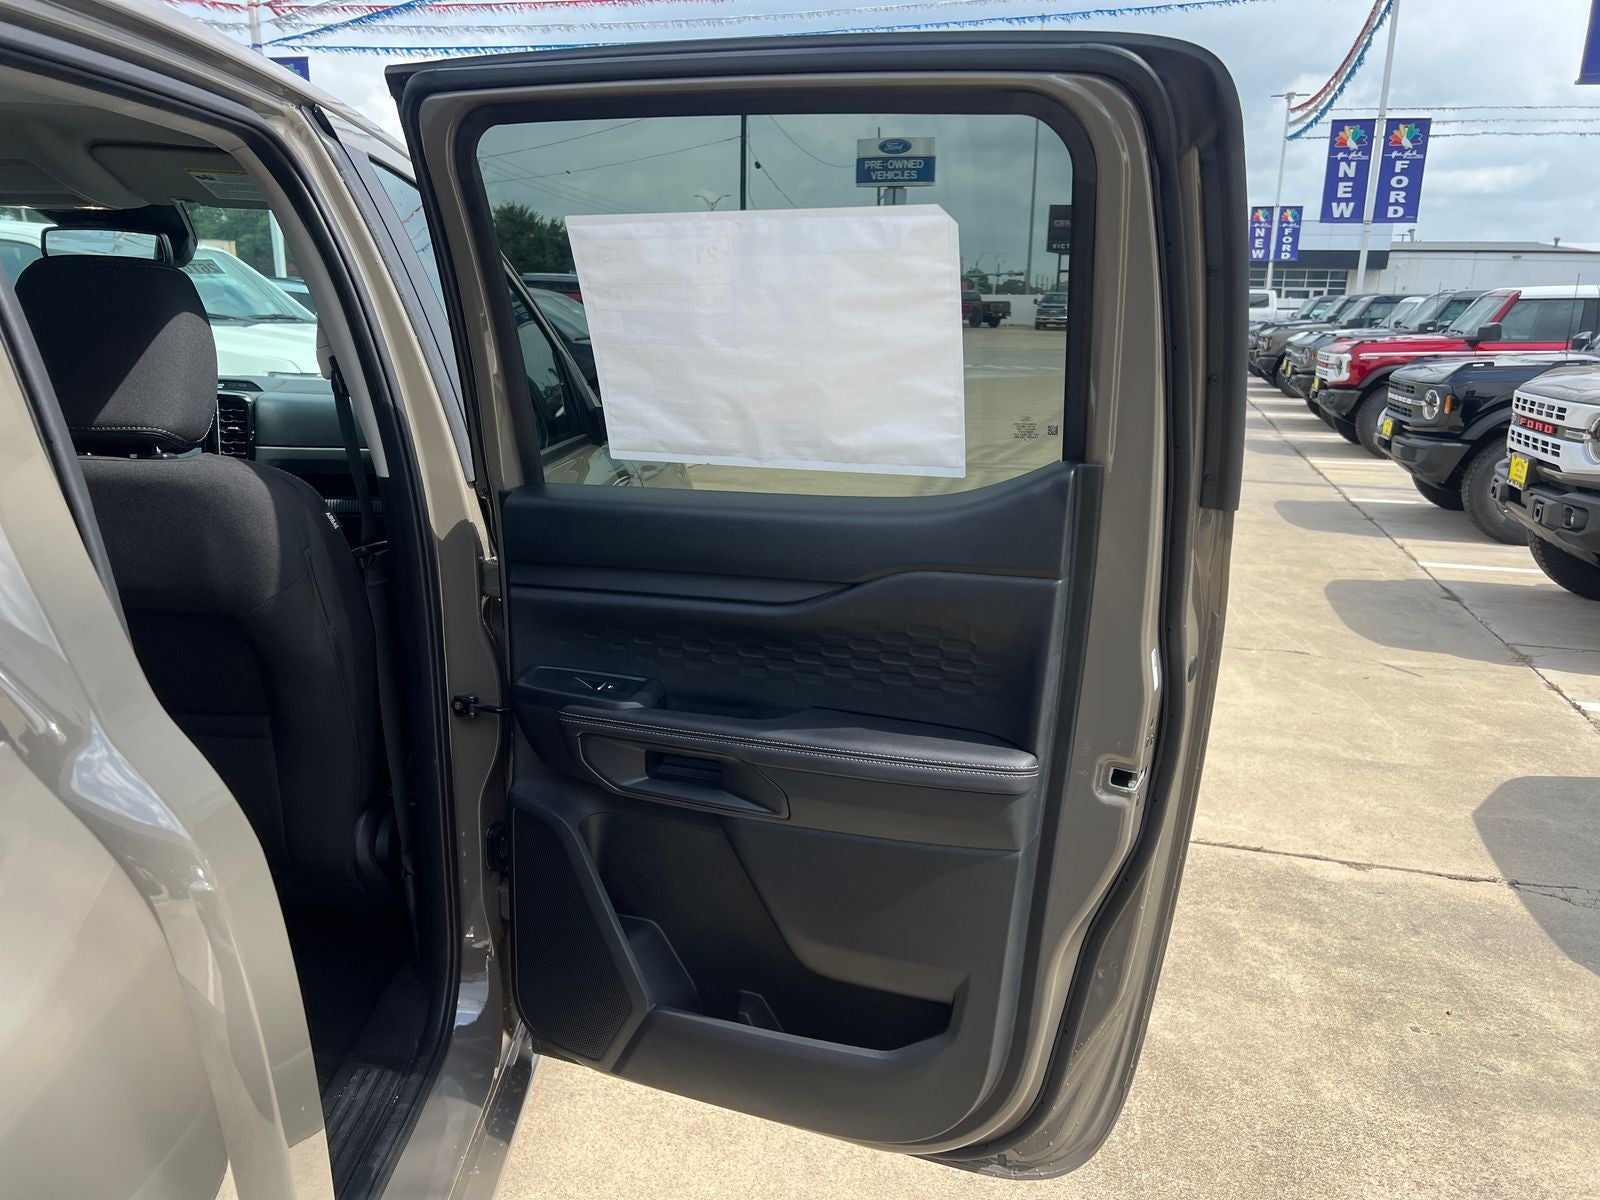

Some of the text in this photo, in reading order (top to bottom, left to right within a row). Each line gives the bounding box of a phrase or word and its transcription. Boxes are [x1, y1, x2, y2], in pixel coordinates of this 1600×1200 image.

[883, 141, 907, 152] Ford
[864, 159, 925, 170] PRE-OWNED
[870, 170, 918, 180] VEHICLES
[1331, 161, 1357, 218] NEW
[1386, 160, 1410, 218] FORD
[1251, 228, 1266, 259] NEW
[1280, 228, 1293, 260] FORD
[1519, 417, 1554, 435] FORD
